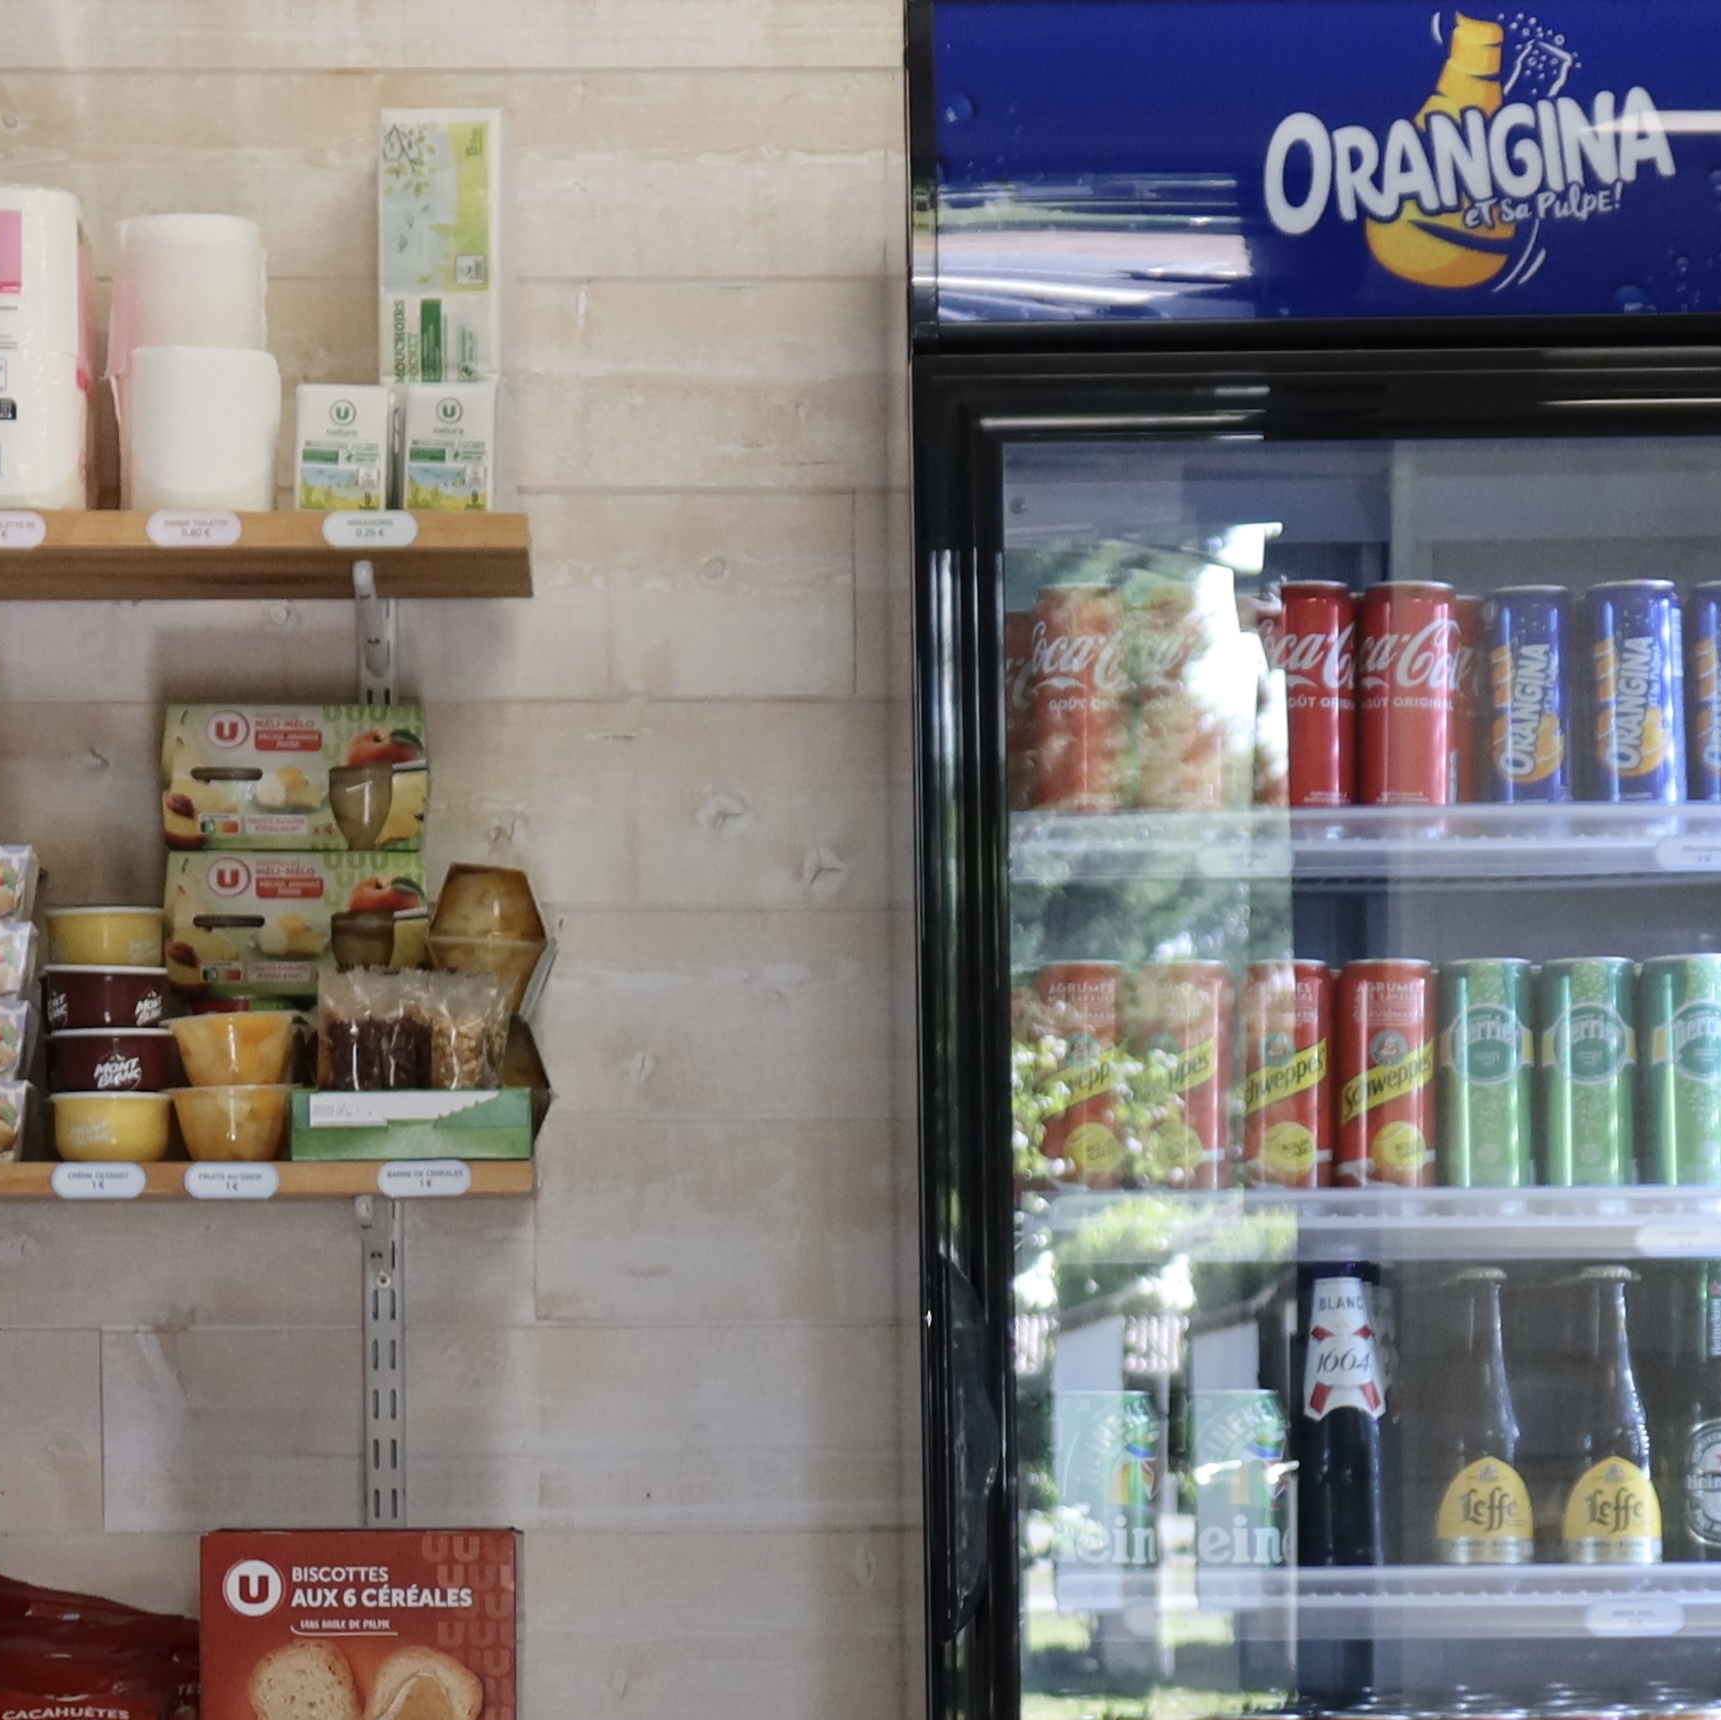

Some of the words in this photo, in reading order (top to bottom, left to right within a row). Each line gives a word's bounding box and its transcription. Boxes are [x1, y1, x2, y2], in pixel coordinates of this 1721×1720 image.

[1264, 86, 1676, 236] ORANGINA
[394, 299, 407, 383] MOUCHOIRS
[1499, 643, 1551, 777] ORANGINA
[1604, 635, 1655, 770] ORANGINA
[214, 721, 239, 741] U
[93, 1057, 140, 1079] MONT
[1316, 1348, 1374, 1374] 1664
[1458, 1485, 1519, 1533] Leffe
[1584, 1484, 1646, 1534] Leffe
[238, 1575, 270, 1603] U
[291, 1566, 389, 1583] BISCOTTES
[291, 1588, 337, 1608] AUX
[342, 1588, 358, 1608] 6
[360, 1583, 473, 1608] CÉRÉALES
